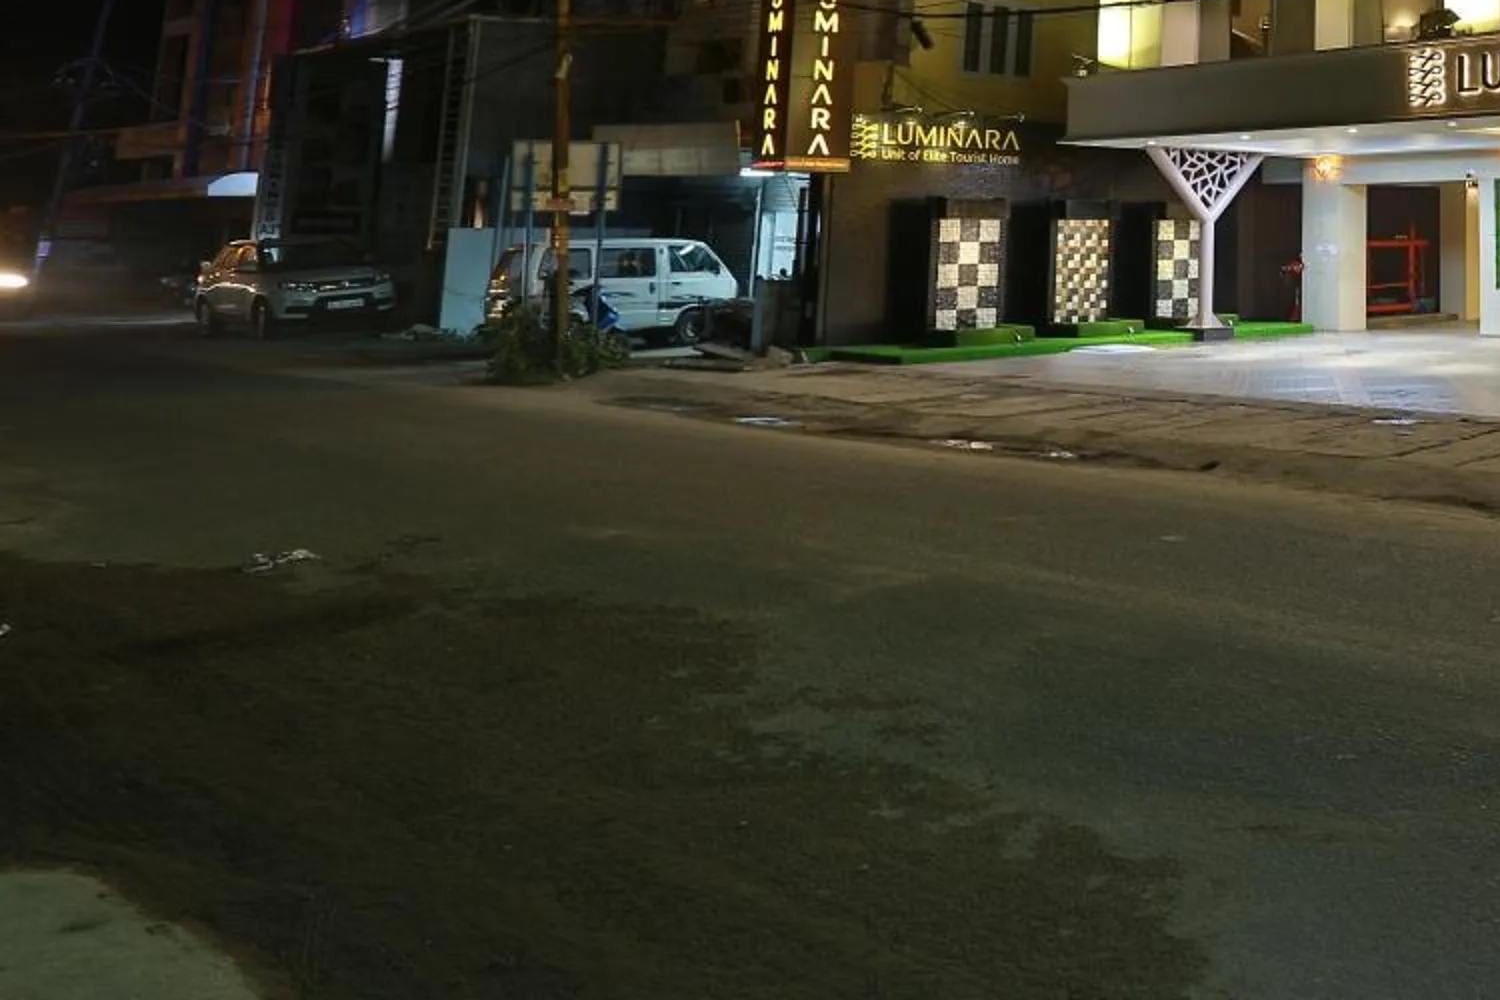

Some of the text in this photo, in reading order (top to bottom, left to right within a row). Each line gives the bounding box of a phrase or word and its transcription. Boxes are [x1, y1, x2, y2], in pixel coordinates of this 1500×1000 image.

[882, 122, 1020, 151] LUMINARA
[881, 148, 1020, 166] Unit of Elite Tourist Home
